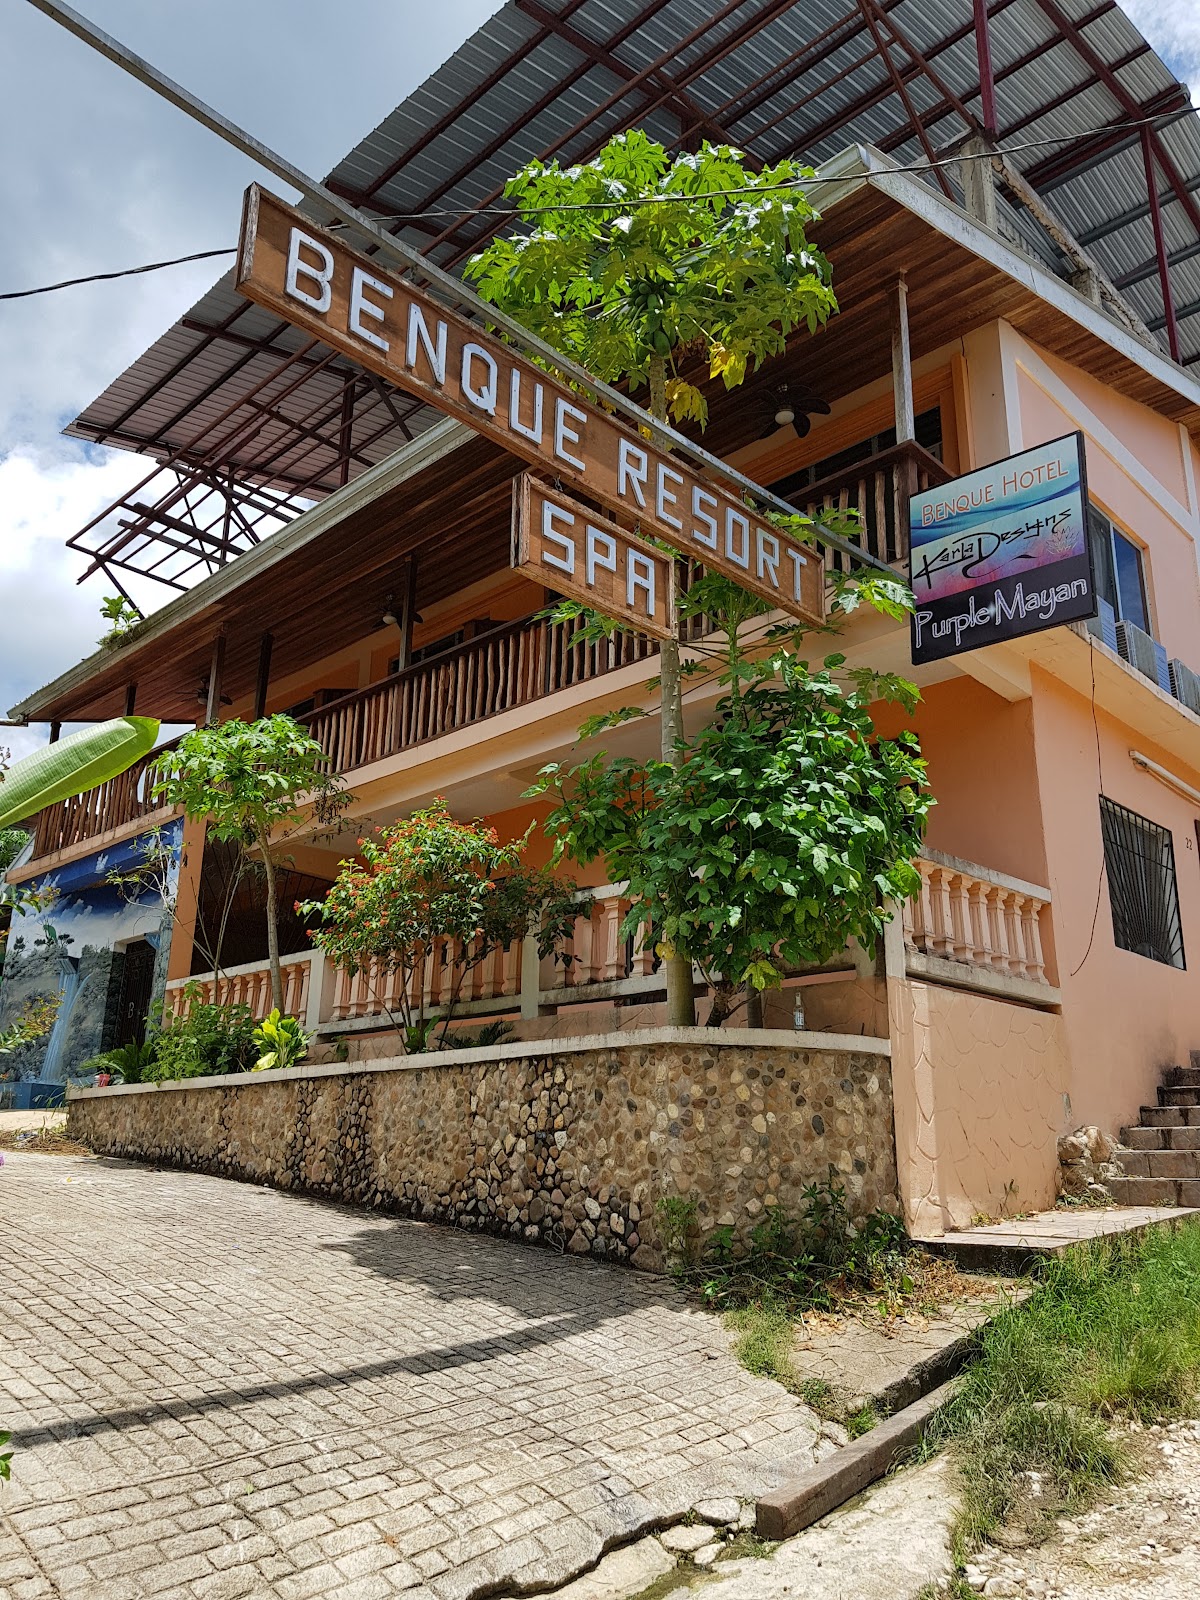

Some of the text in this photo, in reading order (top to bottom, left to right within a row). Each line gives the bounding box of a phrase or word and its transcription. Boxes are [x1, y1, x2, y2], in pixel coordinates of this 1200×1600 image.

[284, 226, 808, 601] BENQUE RESORT
[922, 459, 1069, 527] BENQUE HOTEL
[541, 499, 656, 617] SPA
[913, 508, 1072, 590] Karla Designs
[914, 577, 1088, 649] Purple Mayan
